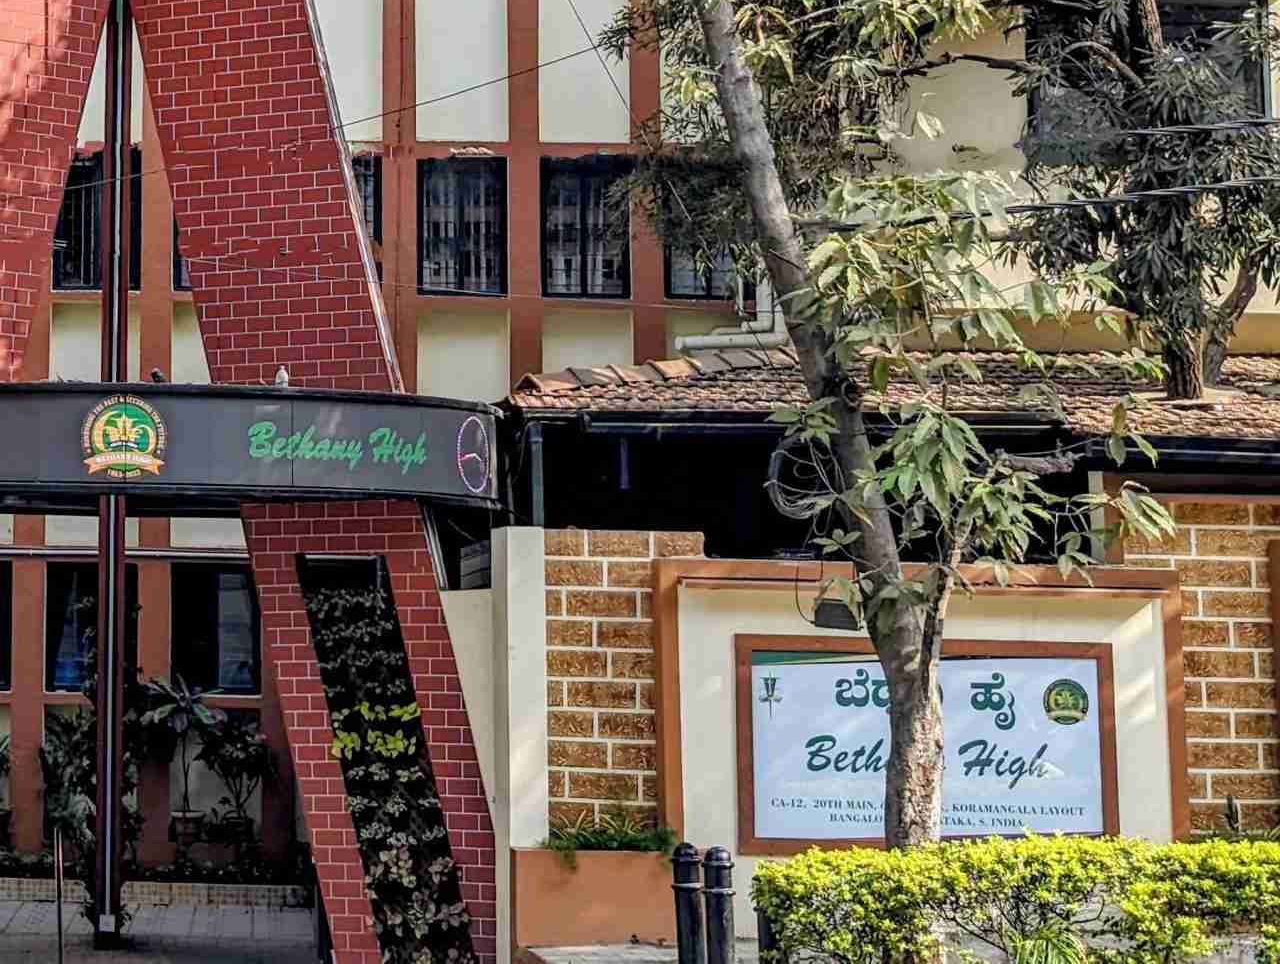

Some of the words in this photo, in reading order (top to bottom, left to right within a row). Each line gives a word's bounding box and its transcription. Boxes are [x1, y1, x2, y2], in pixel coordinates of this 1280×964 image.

[247, 421, 365, 471] Bethany
[368, 427, 428, 475] High
[970, 671, 1016, 730] ಹೈ
[958, 739, 1049, 789] High
[813, 798, 842, 809] 20TH
[952, 803, 1037, 815] KORAMANGALA
[1040, 806, 1087, 817] LAYOUT
